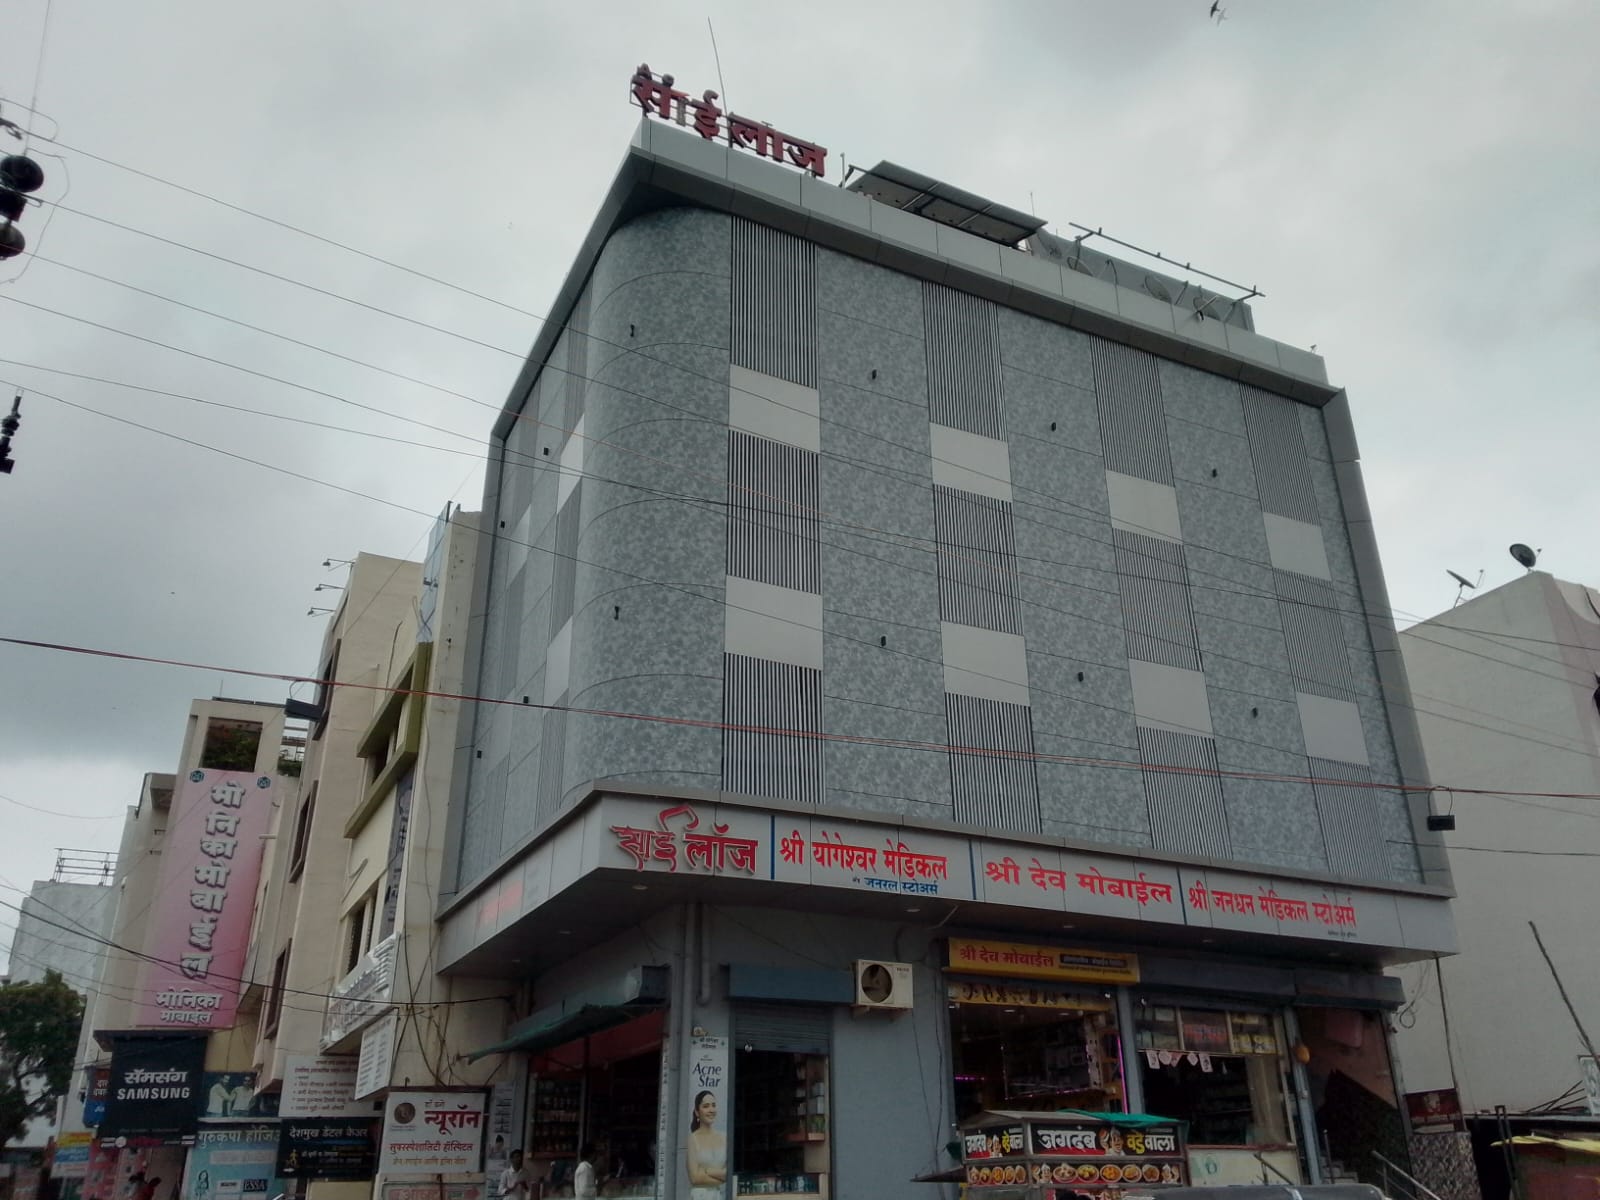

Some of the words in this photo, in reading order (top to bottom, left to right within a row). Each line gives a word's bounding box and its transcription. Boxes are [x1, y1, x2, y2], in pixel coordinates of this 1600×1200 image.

[683, 822, 759, 875] लॉज
[780, 829, 805, 865] श्री
[811, 830, 878, 874] योगेश्वर
[883, 838, 948, 881] मेडिकल
[864, 877, 898, 892] जनरल
[985, 856, 1021, 886] श्री
[1028, 858, 1067, 892] देव
[1075, 866, 1173, 907] मोबाईल
[1189, 880, 1209, 913] श्री
[1258, 886, 1310, 923] मेडिकल
[959, 945, 976, 961] श्री
[692, 1062, 722, 1076] Acne
[697, 1074, 721, 1088] Star
[117, 1087, 191, 1101] SAMSUNG
[424, 1104, 482, 1136] न्यूरॉन
[289, 1125, 320, 1141] देशमुख
